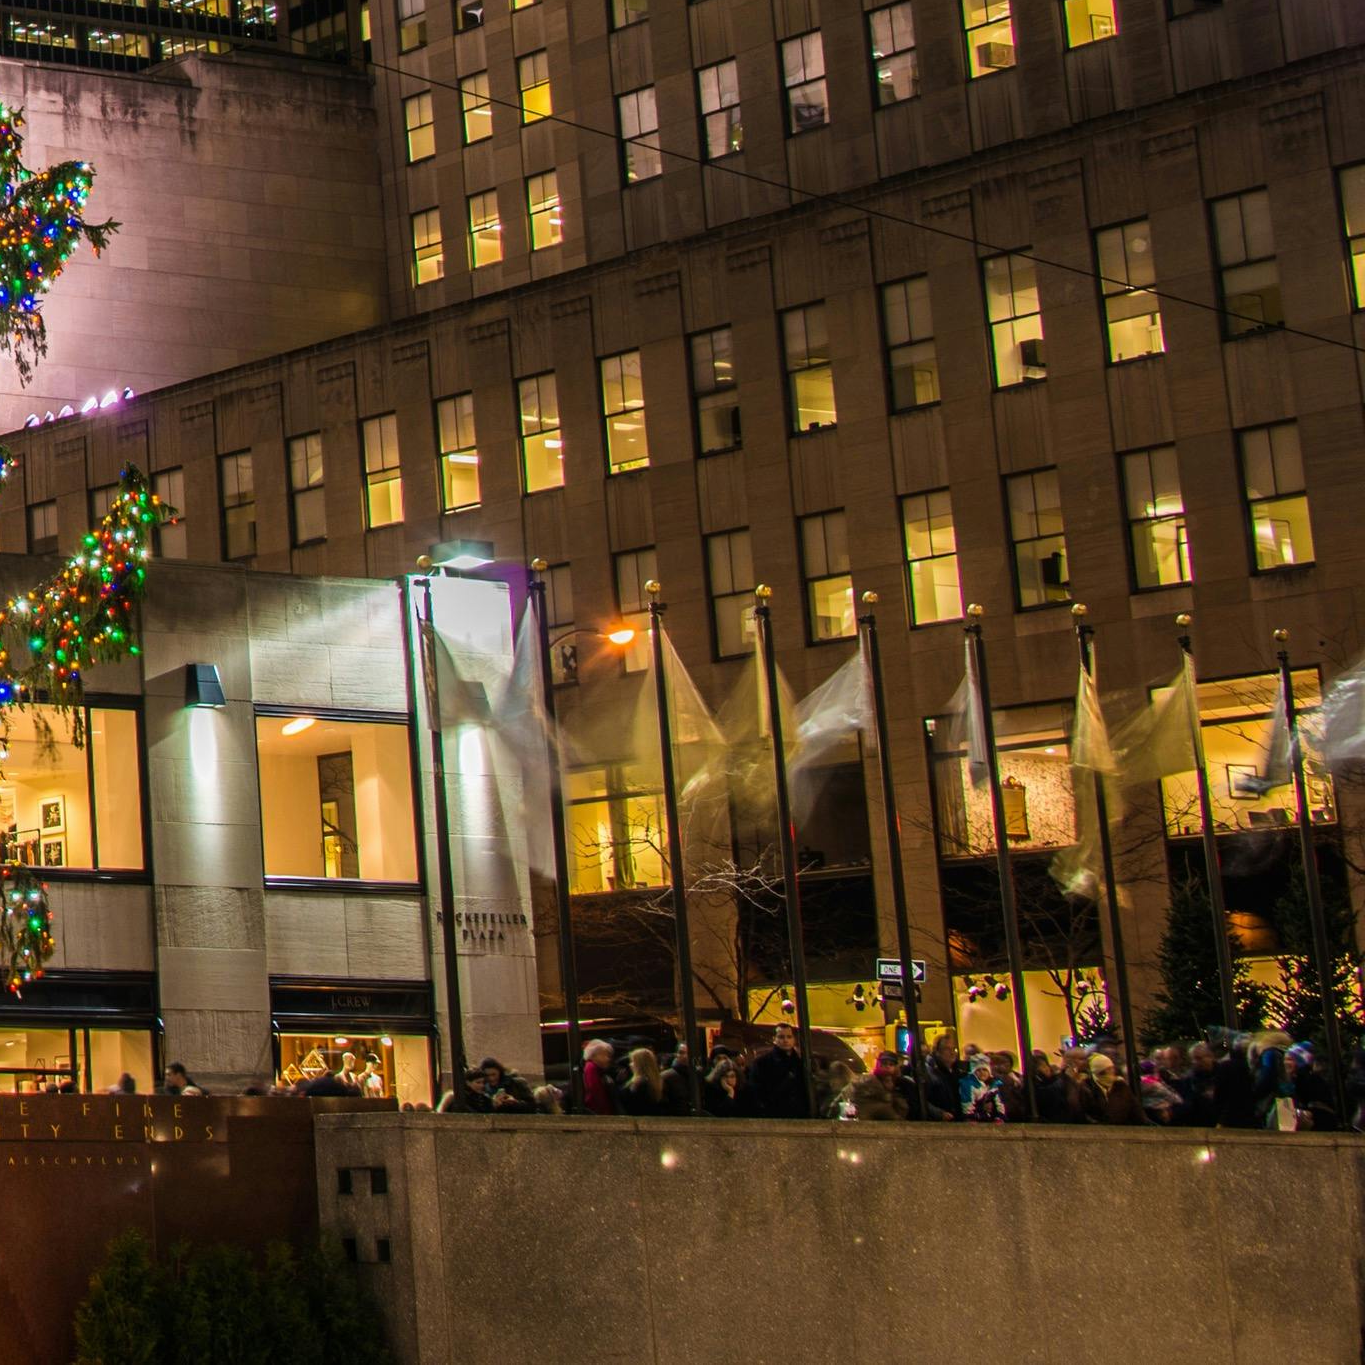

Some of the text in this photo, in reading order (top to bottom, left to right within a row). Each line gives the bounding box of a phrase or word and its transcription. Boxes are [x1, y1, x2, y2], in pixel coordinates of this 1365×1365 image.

[436, 911, 527, 925] RCKEFELLER
[462, 929, 505, 940] PLAZA
[82, 1102, 182, 1119] FIRE
[115, 1125, 214, 1140] ENDS
